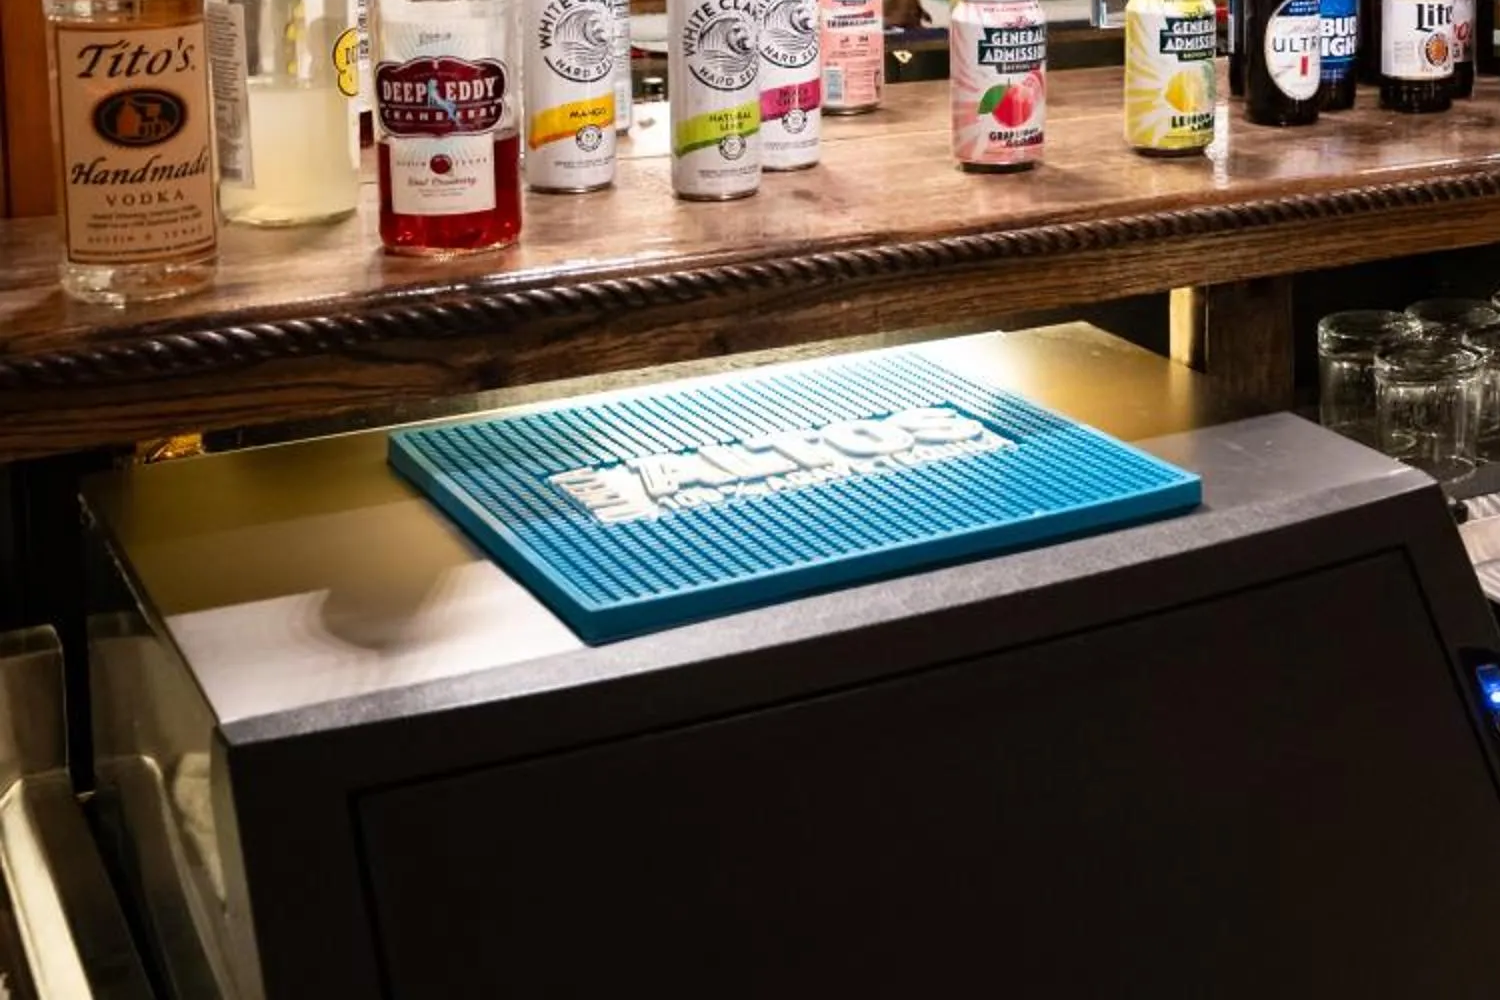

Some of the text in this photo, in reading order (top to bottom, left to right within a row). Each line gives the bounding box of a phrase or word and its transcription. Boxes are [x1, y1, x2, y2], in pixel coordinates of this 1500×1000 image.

[682, 1, 716, 58] WHITE
[76, 36, 195, 79] Tito's
[382, 75, 497, 103] DEEP EDDY
[105, 189, 185, 208] VODKA
[624, 405, 987, 498] ALTOS
